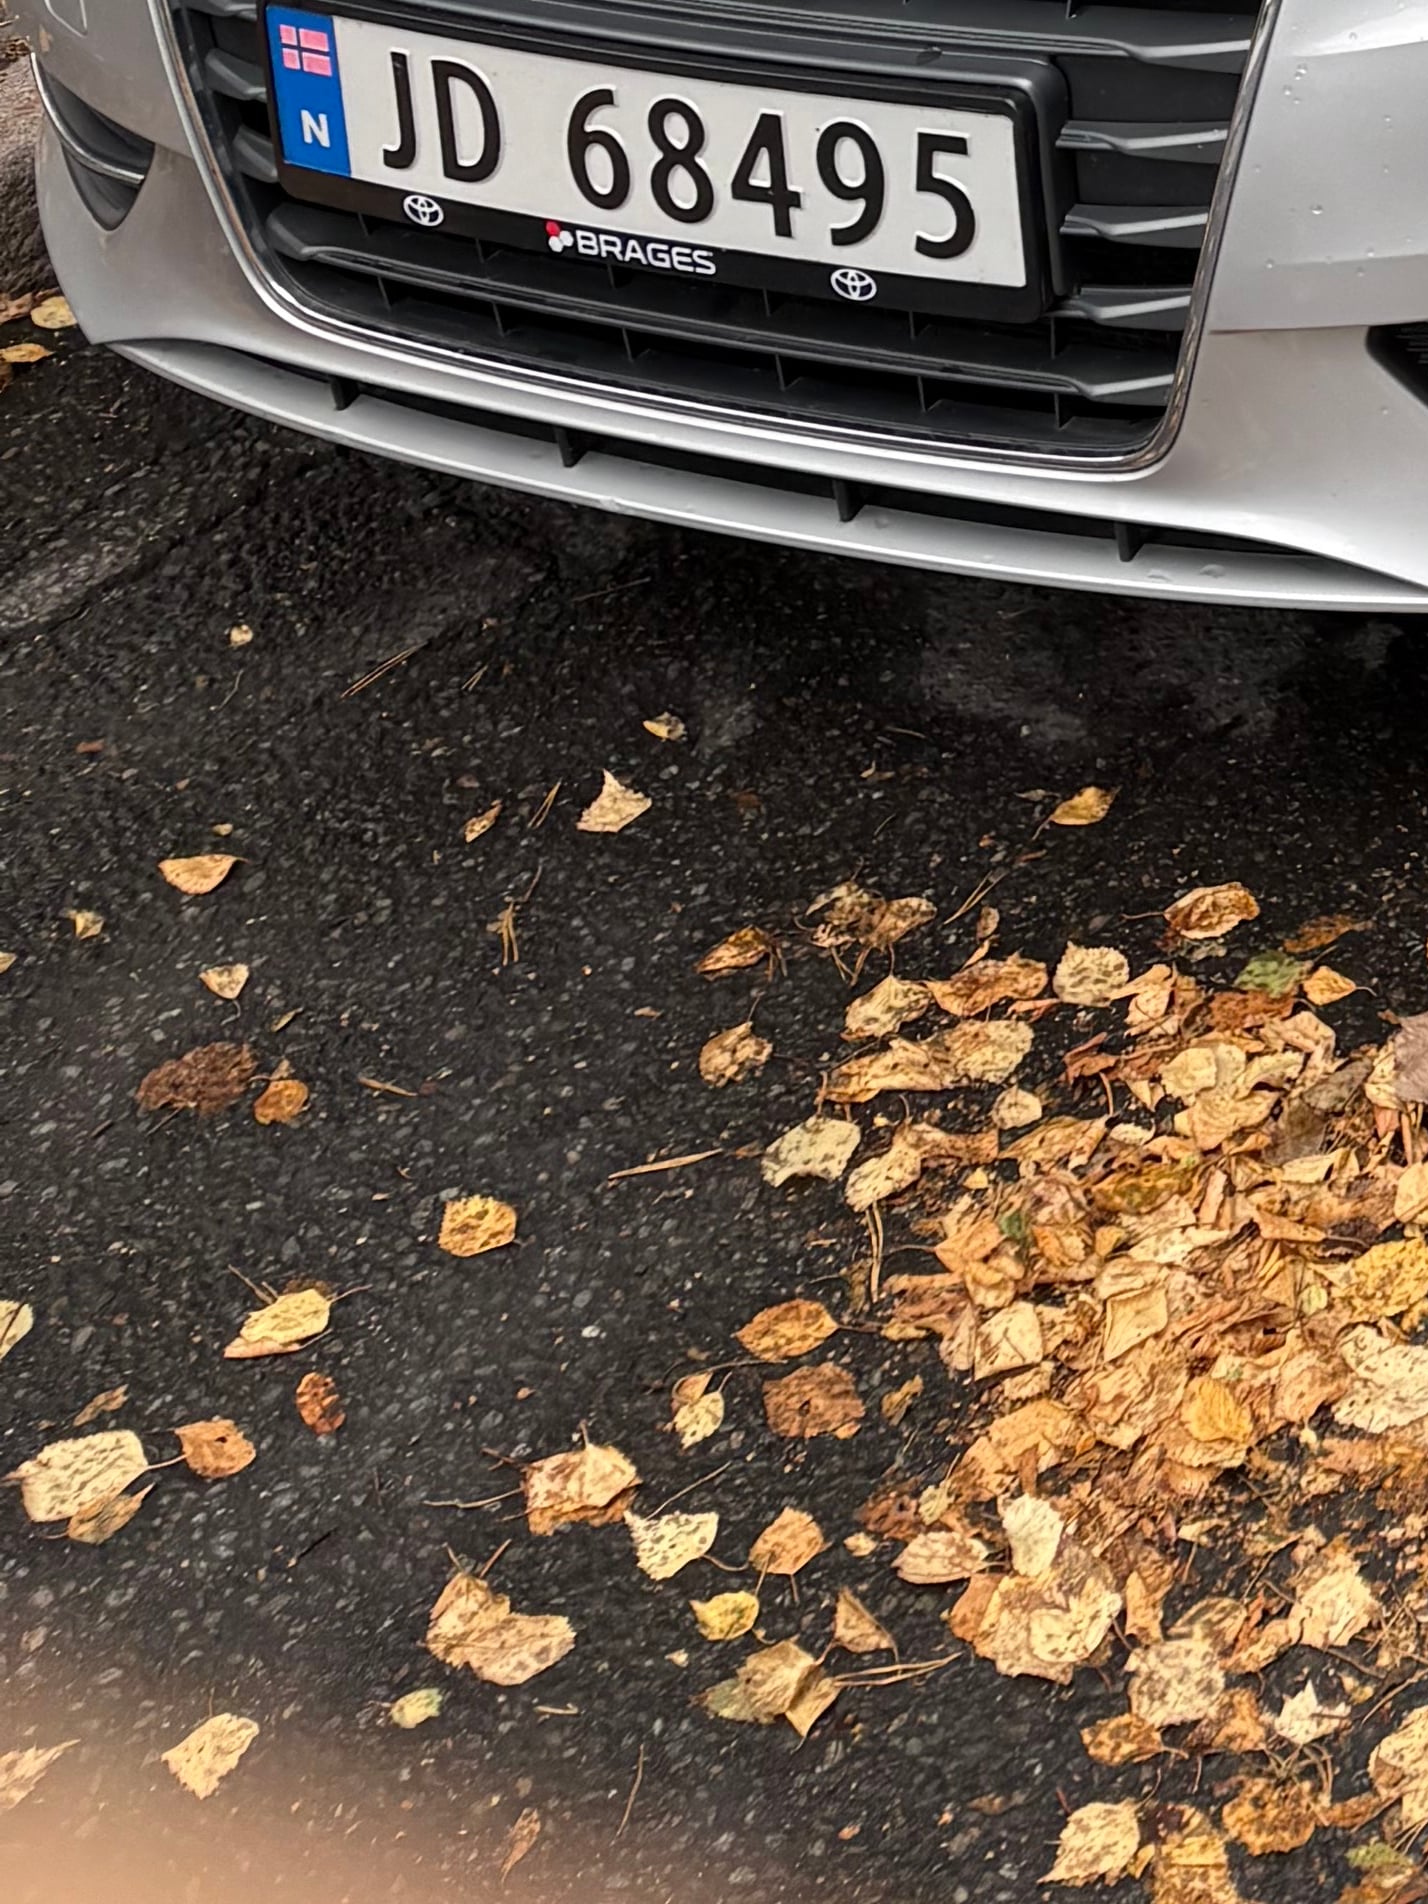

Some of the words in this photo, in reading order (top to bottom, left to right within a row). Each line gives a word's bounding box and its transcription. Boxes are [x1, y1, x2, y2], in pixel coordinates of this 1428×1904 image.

[301, 109, 331, 148] N
[382, 49, 501, 184] JD
[567, 88, 977, 260] 68495
[575, 229, 716, 275] BRAGES
